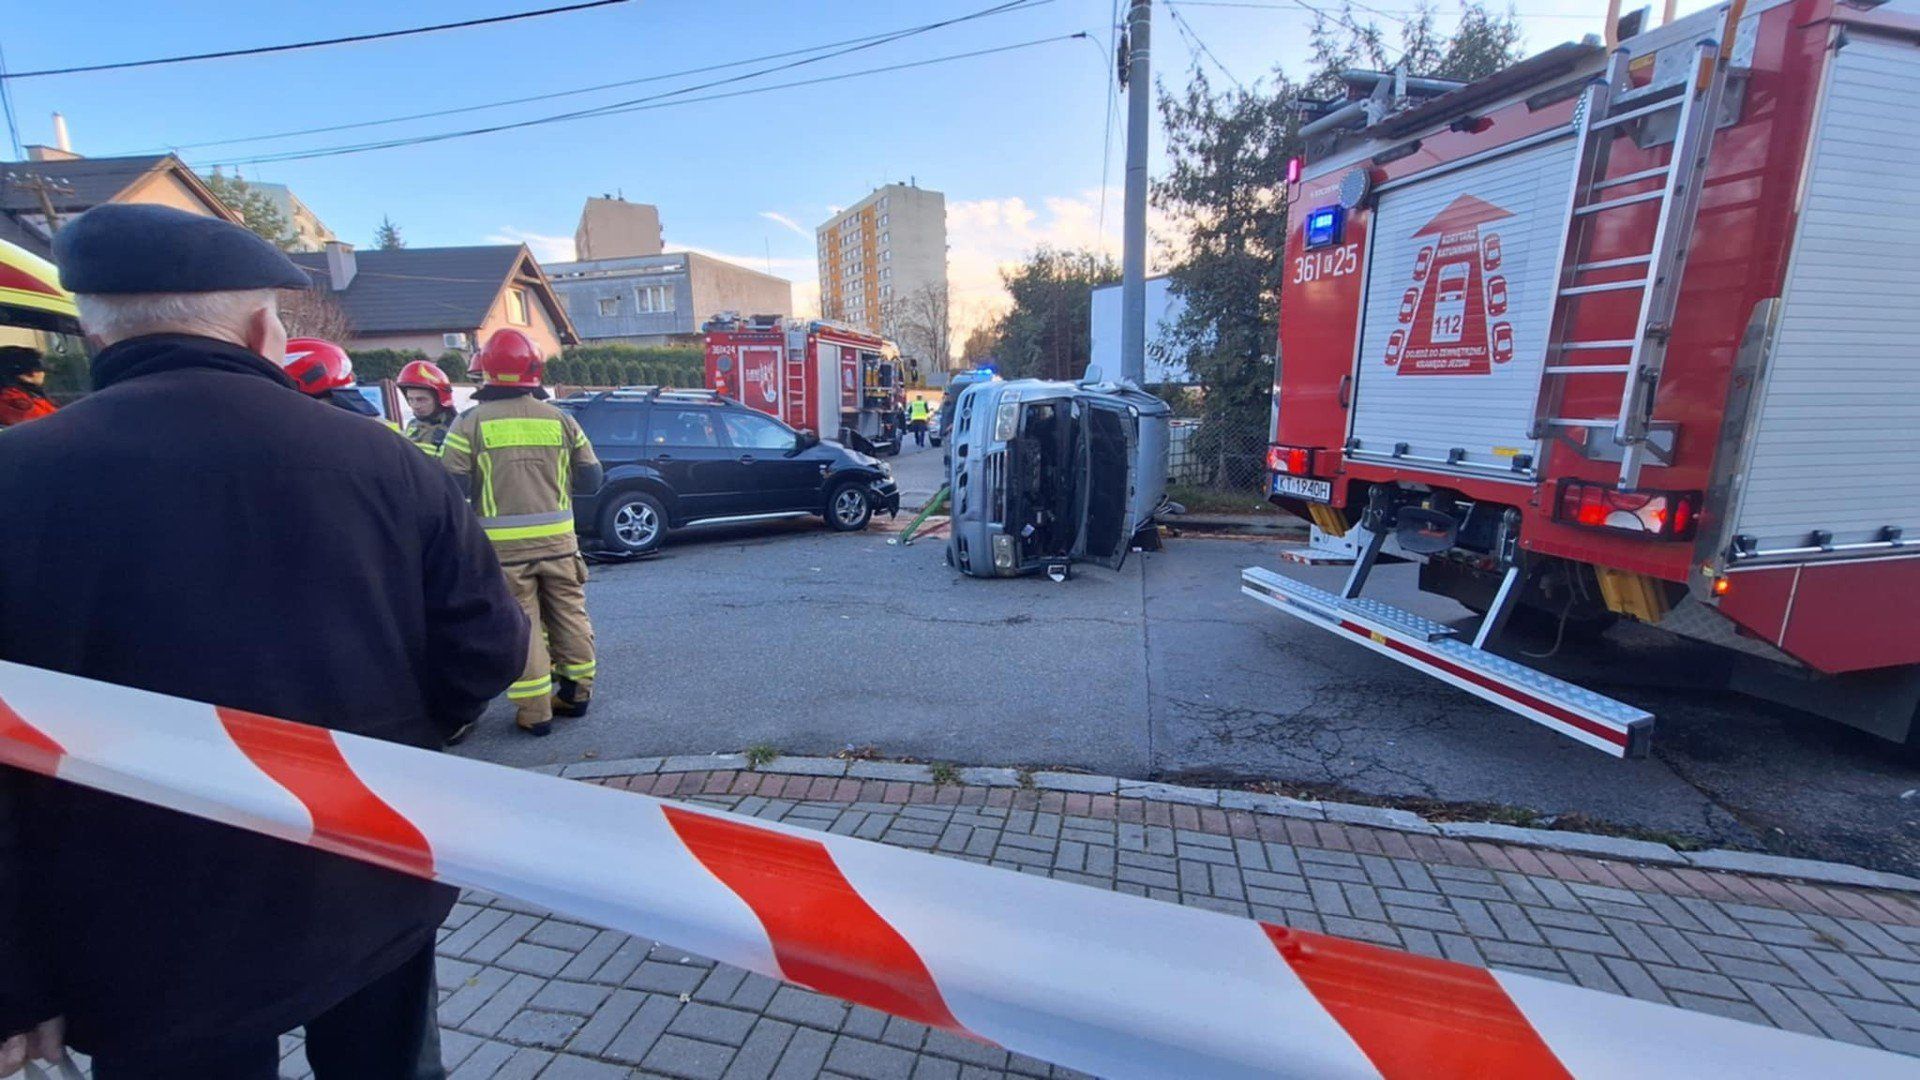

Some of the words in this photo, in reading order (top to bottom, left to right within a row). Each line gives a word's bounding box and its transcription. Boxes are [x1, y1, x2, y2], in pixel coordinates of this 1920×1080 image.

[1293, 253, 1321, 284] 361
[1333, 243, 1358, 276] 25
[1434, 317, 1462, 336] 112
[1278, 477, 1293, 491] KT
[1295, 479, 1328, 498] 1940H
